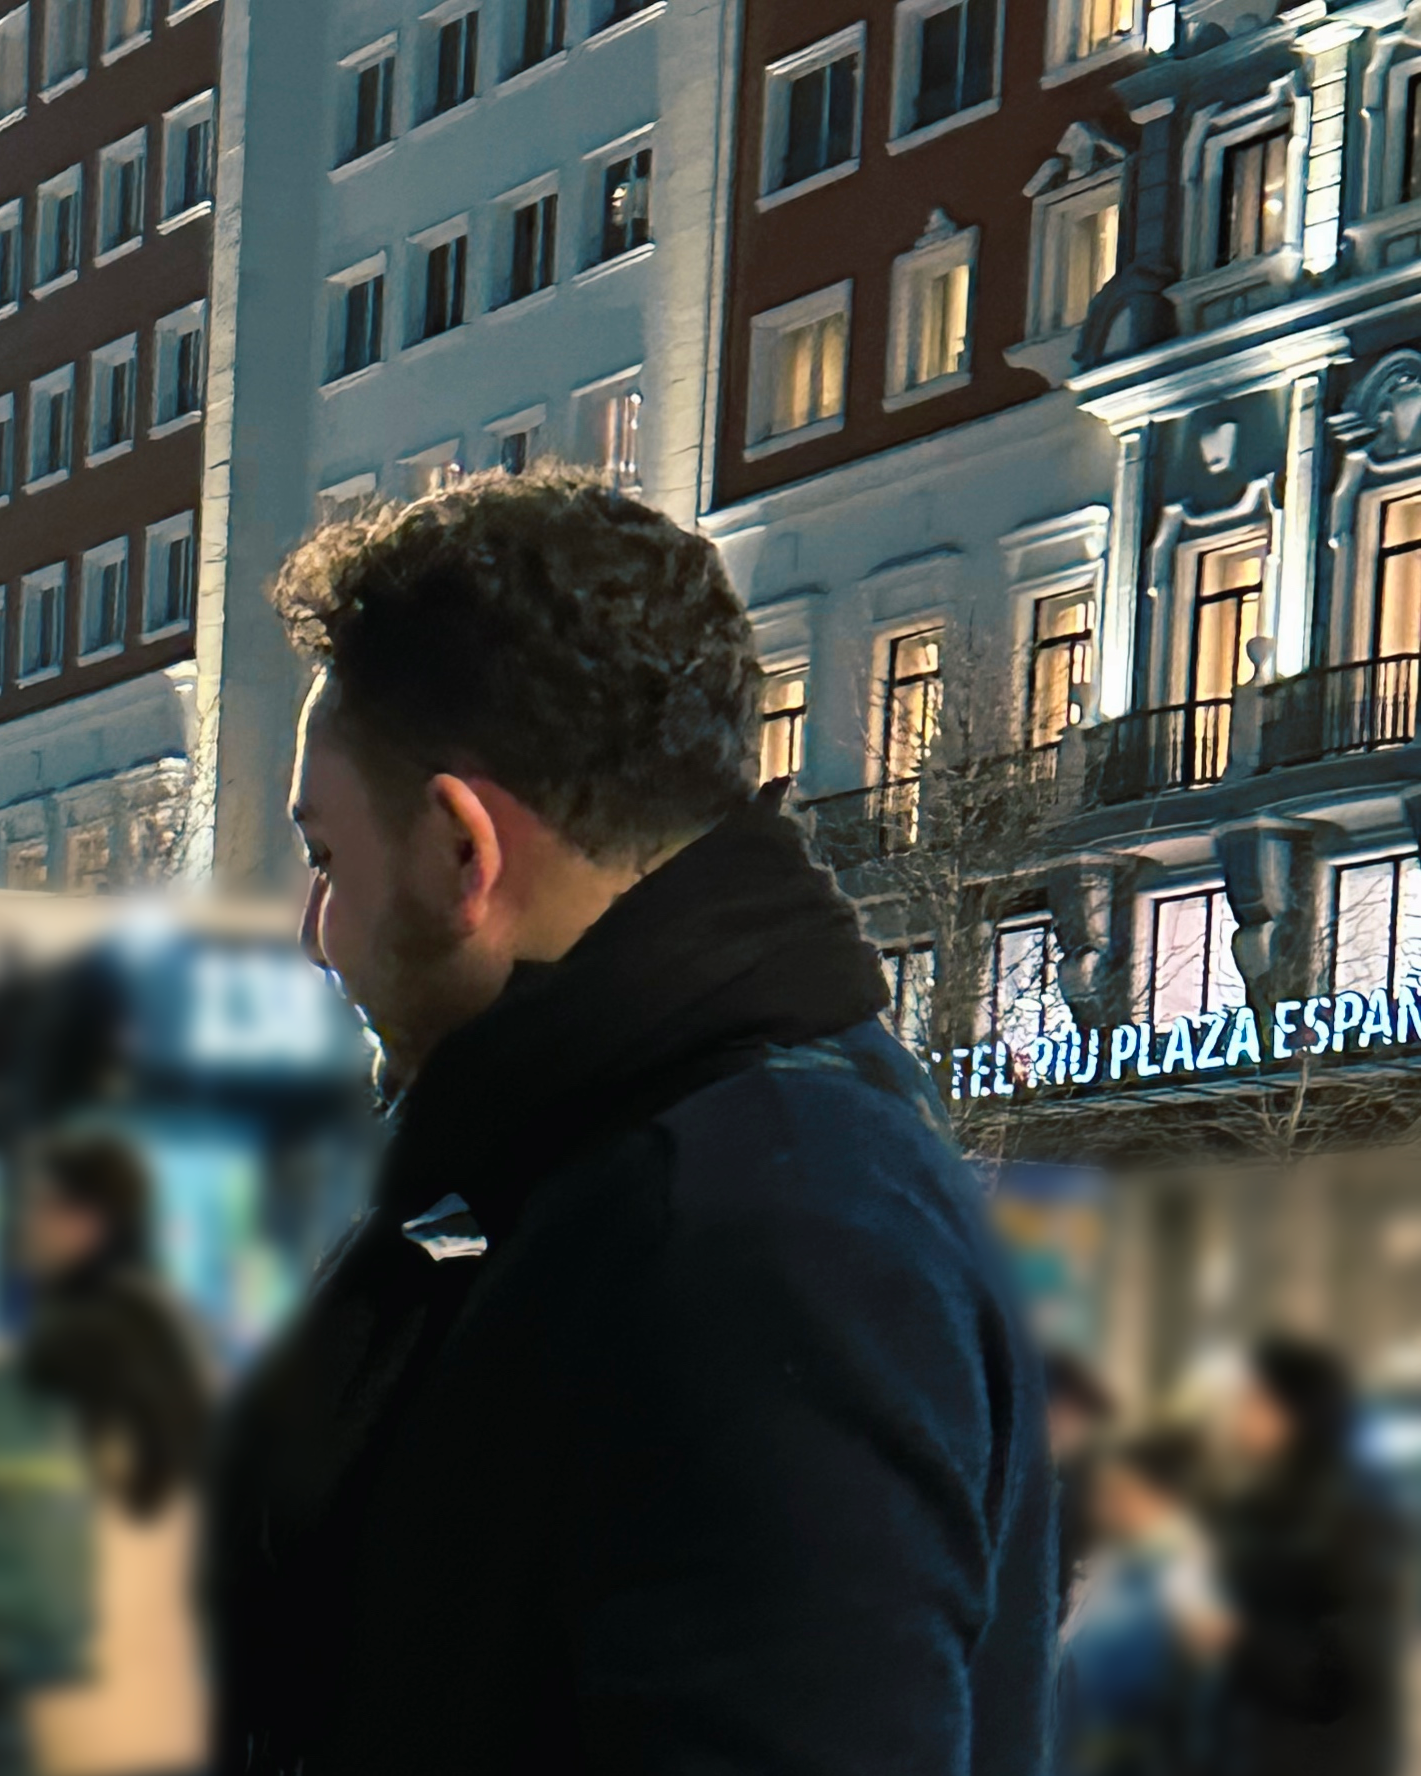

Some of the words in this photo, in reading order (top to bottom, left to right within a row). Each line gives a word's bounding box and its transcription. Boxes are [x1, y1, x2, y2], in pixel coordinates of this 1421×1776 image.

[932, 1040, 1014, 1100] TEL
[1027, 1029, 1099, 1089] RIU
[1110, 1007, 1262, 1080] PLAZA
